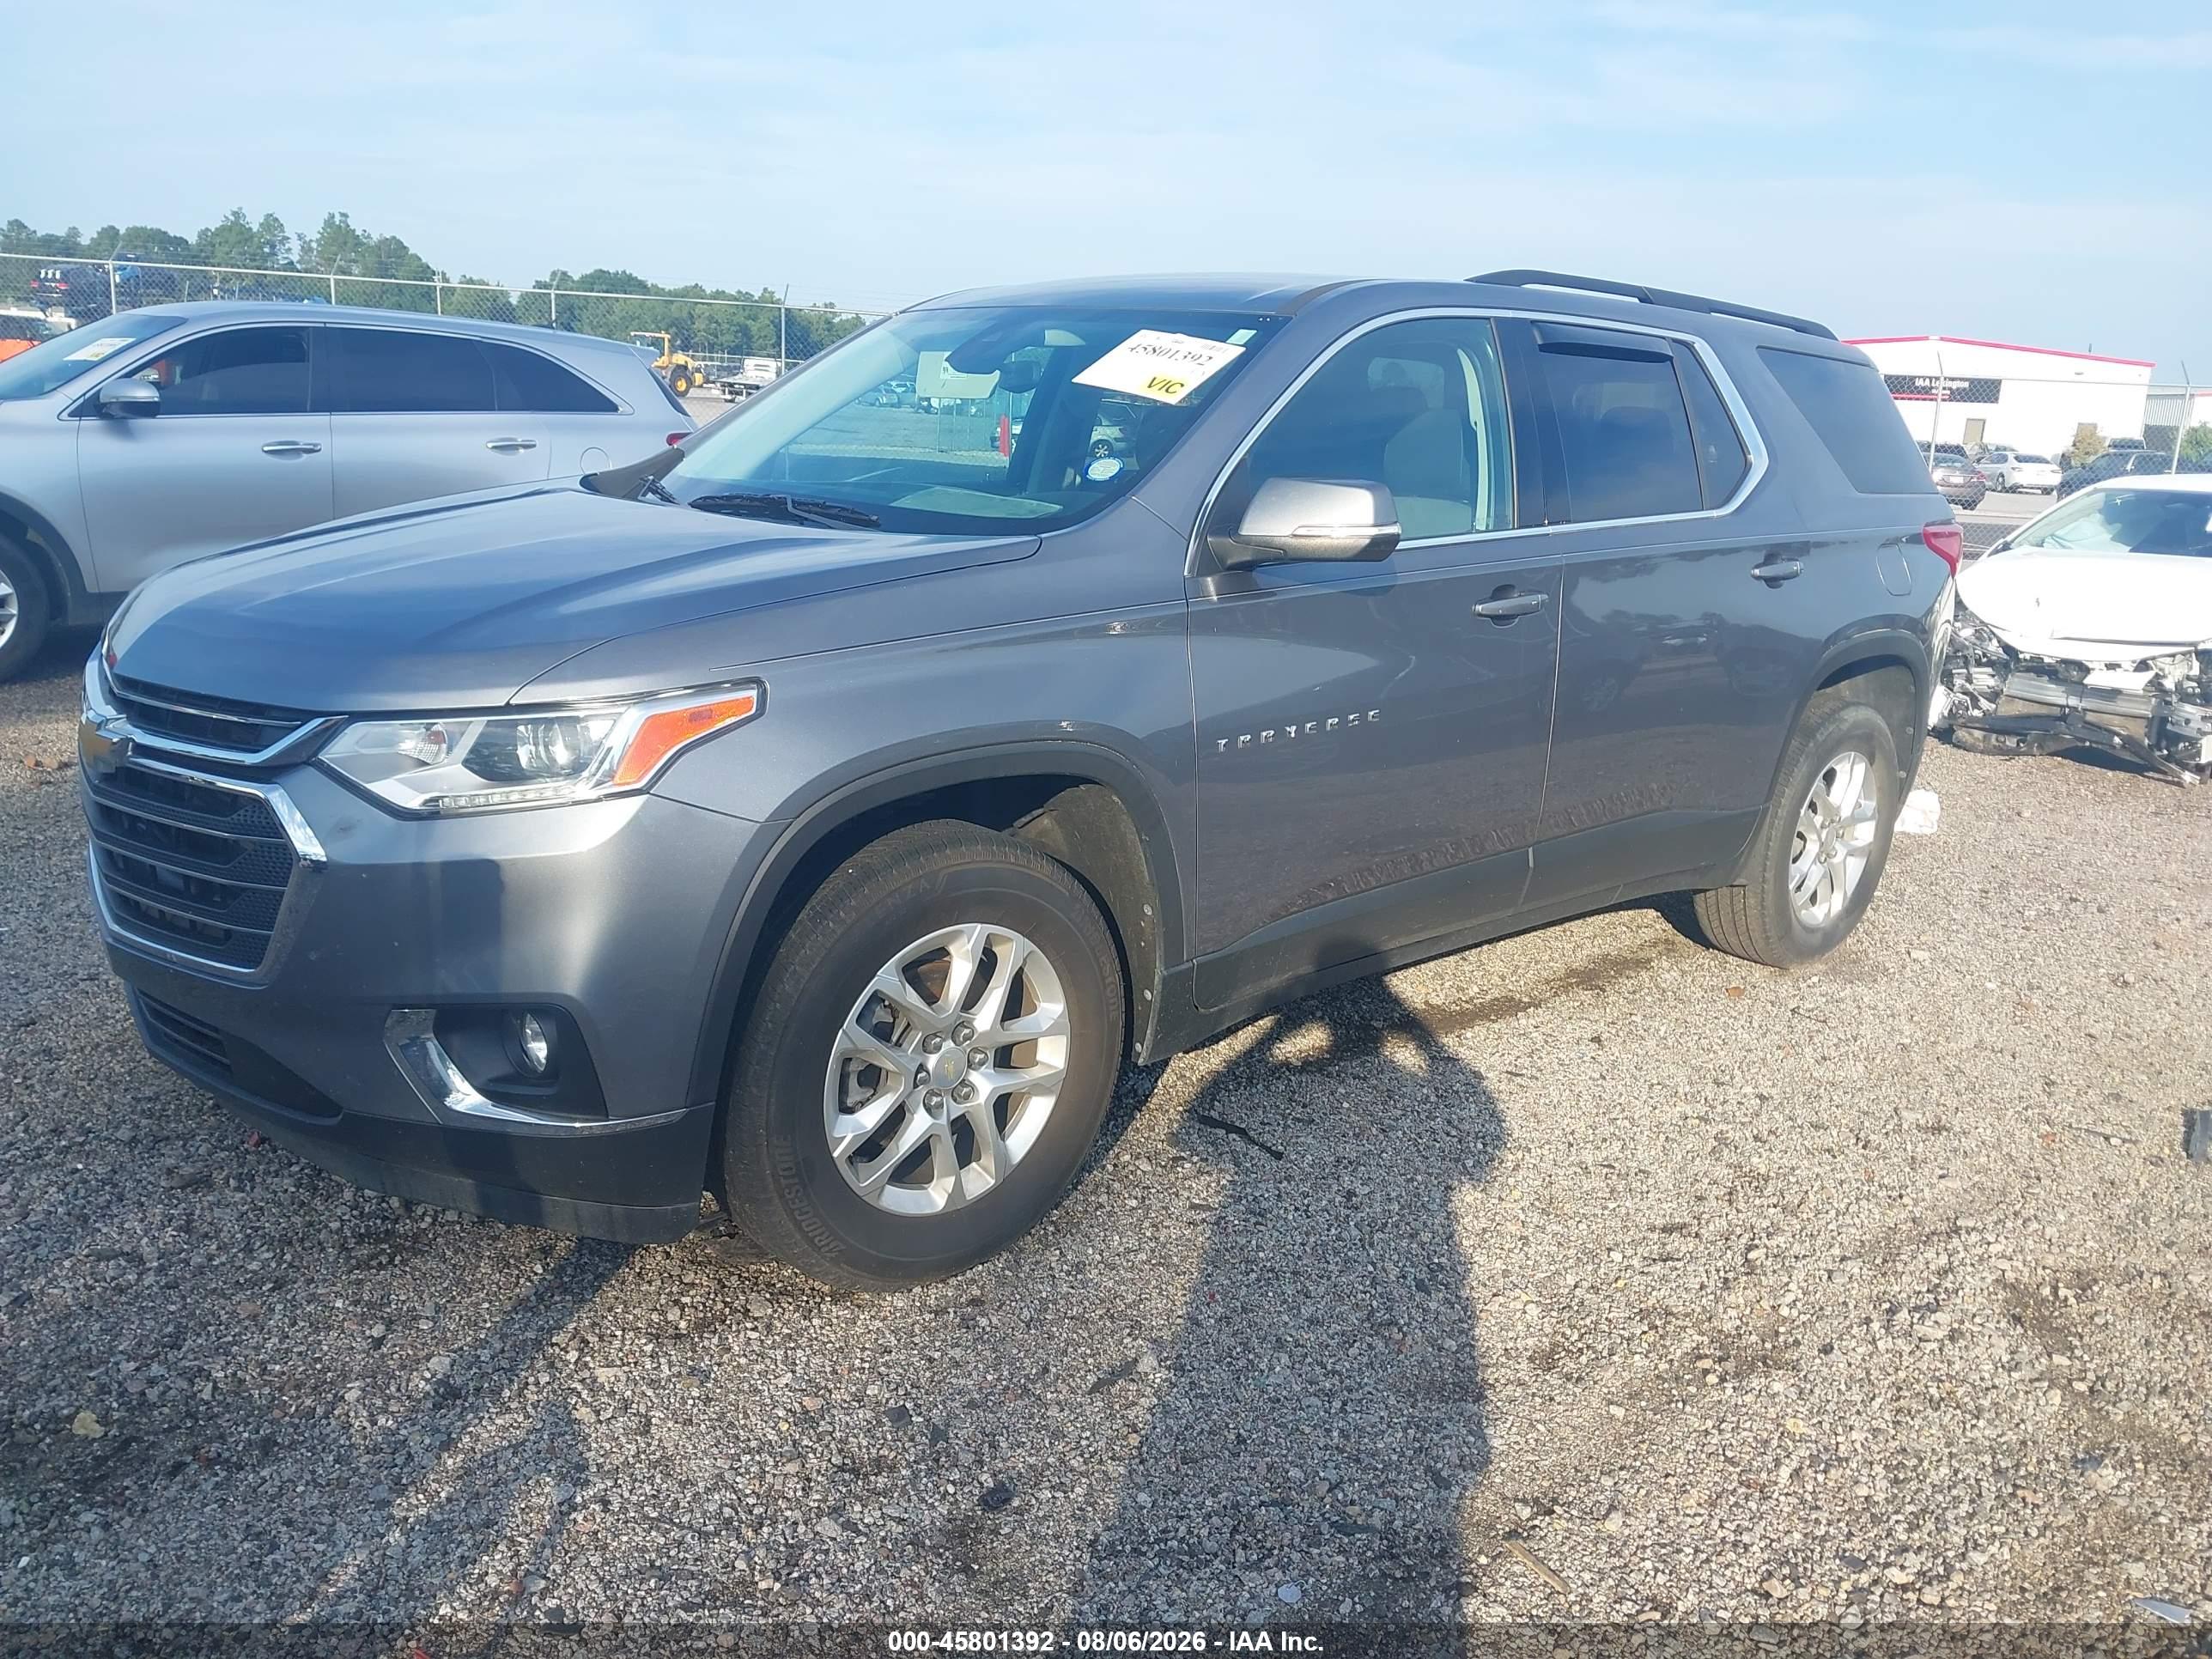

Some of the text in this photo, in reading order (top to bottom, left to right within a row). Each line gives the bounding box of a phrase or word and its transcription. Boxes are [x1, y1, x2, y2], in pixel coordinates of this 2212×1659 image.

[1127, 343, 1213, 367] 45801392
[1146, 376, 1185, 394] VIC
[1914, 377, 1930, 387] IAA
[1215, 708, 1381, 753] TRAVERSE
